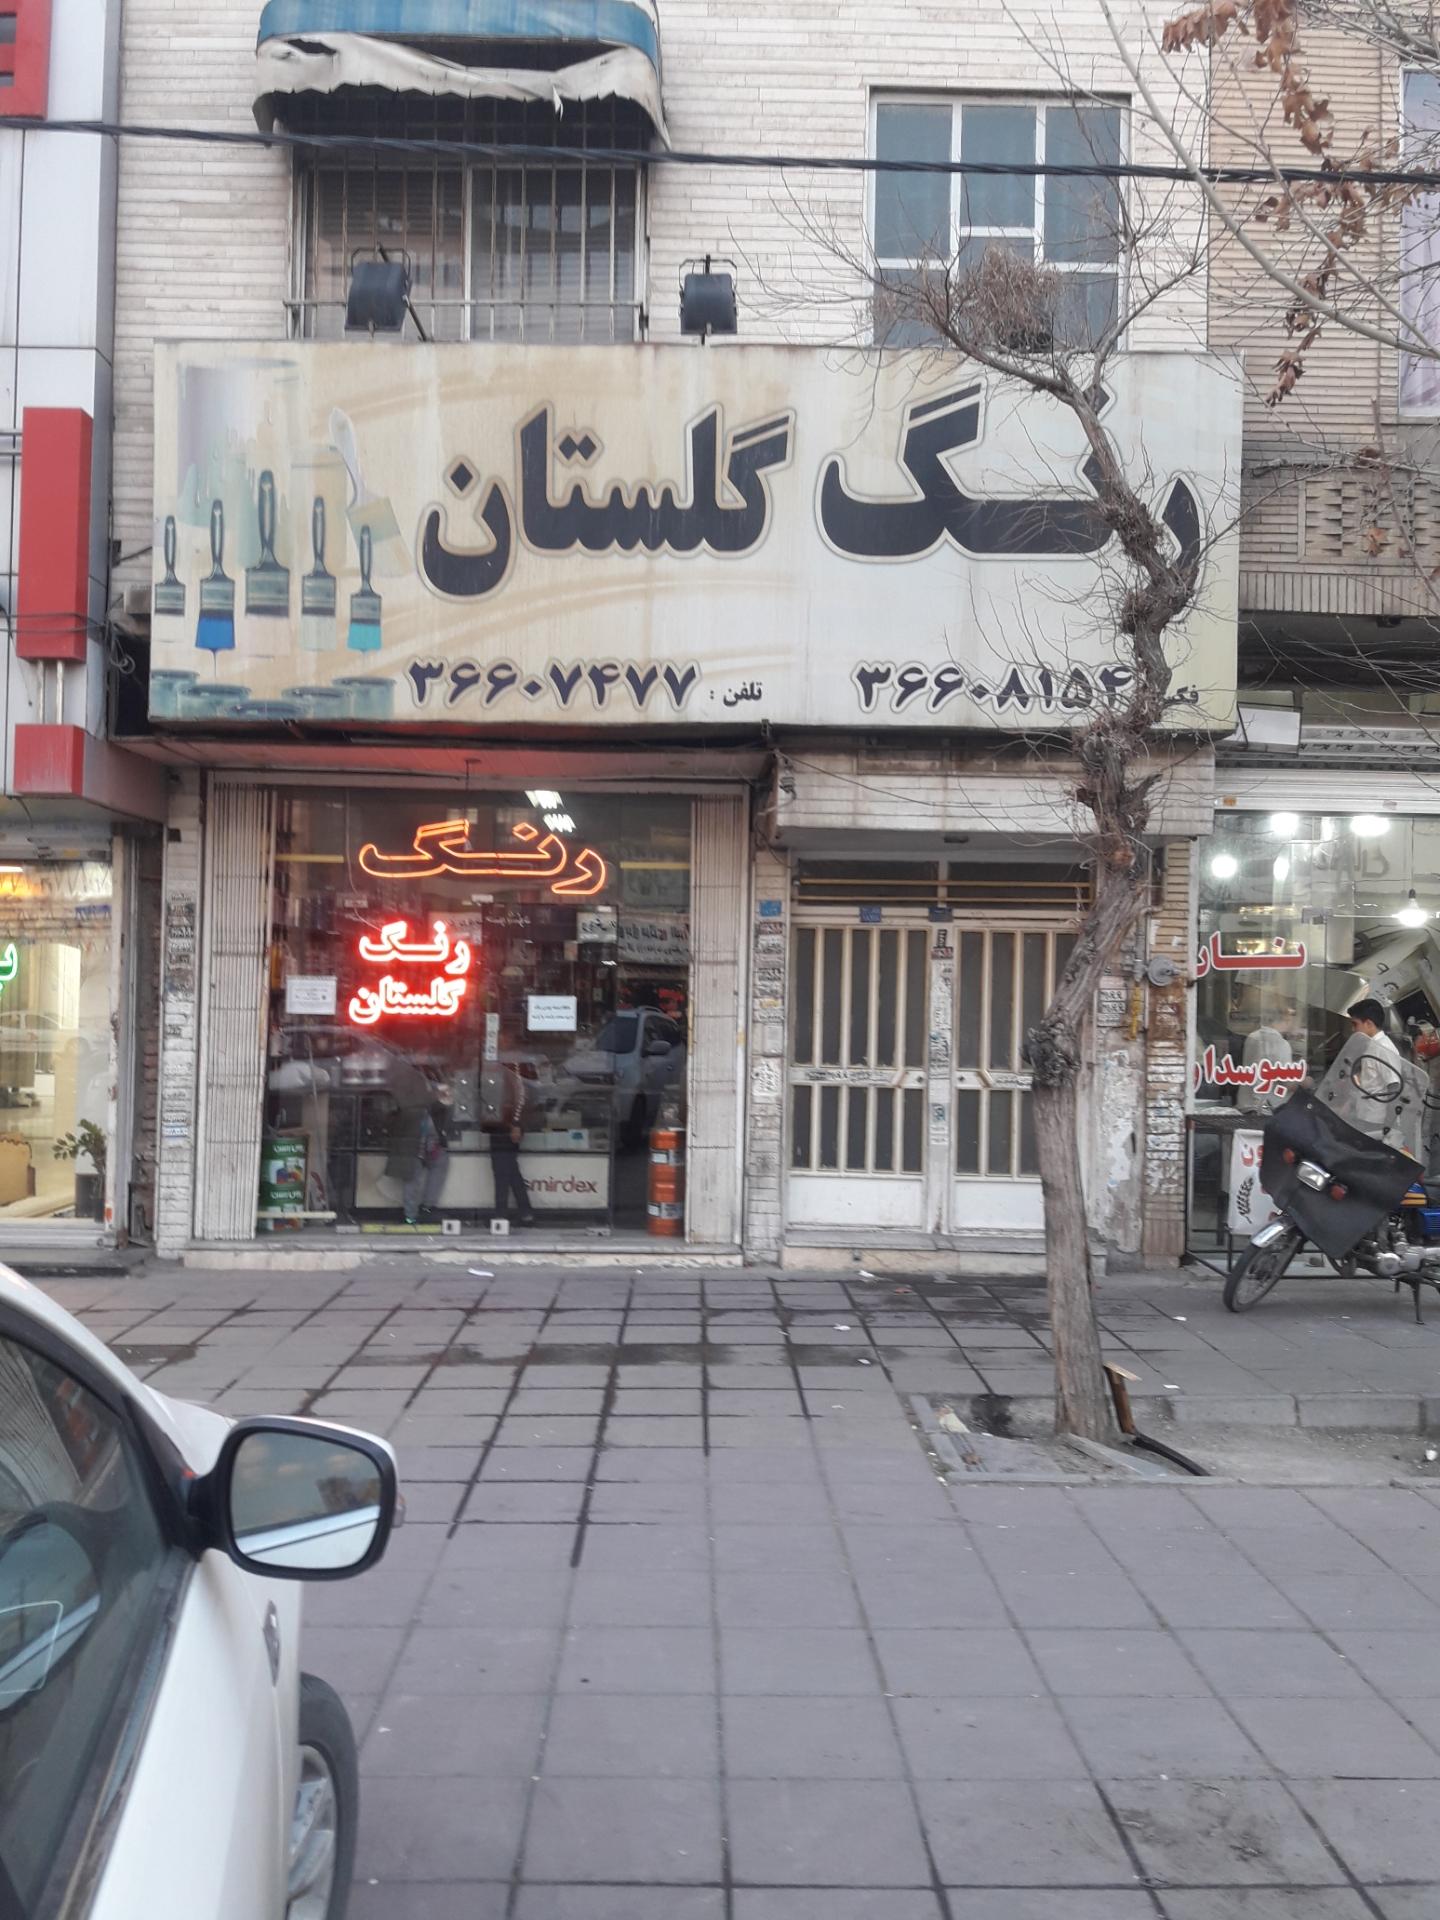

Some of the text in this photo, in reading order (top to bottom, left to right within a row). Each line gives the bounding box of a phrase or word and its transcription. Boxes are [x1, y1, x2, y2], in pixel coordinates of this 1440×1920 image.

[423, 407, 793, 595] گلستان
[408, 659, 697, 707] ۳۶۶۰۷۴۷۷
[360, 818, 606, 894] رنگ
[359, 921, 470, 974] رنگ
[348, 975, 467, 1024] گلستان
